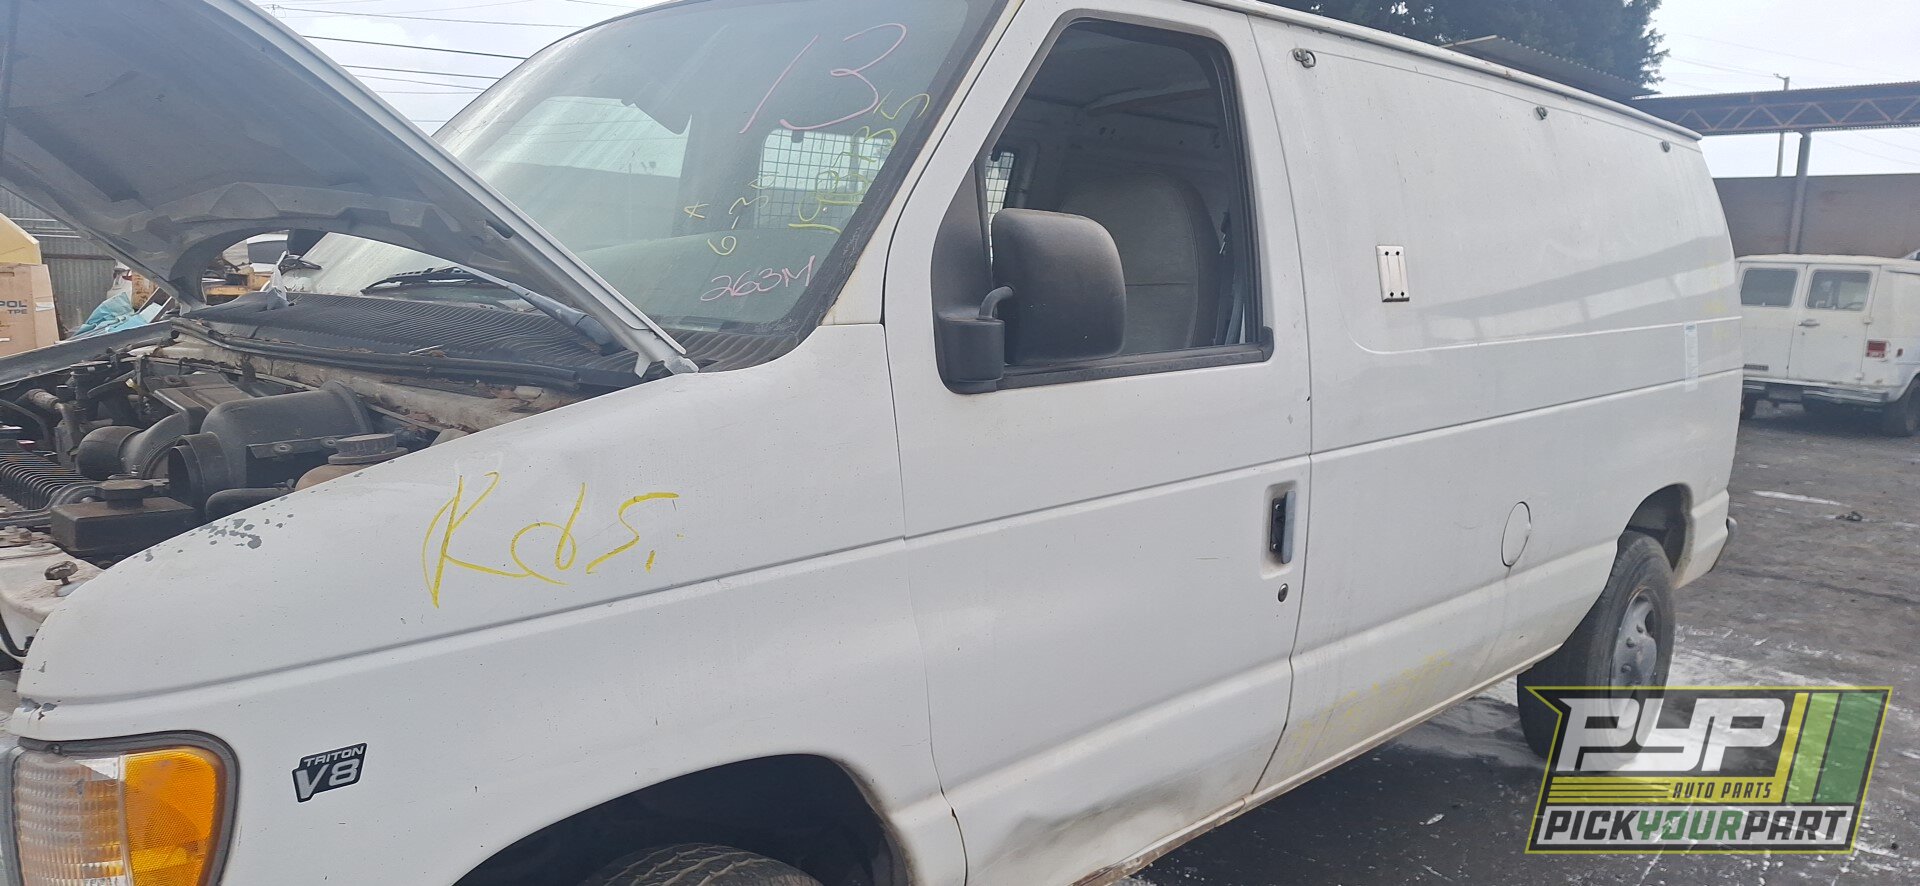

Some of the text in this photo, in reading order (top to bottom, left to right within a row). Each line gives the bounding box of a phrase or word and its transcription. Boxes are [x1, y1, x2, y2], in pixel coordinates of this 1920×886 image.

[738, 23, 907, 134] 13
[701, 255, 815, 301] 263M
[296, 758, 360, 799] V8
[303, 746, 364, 768] TRITON
